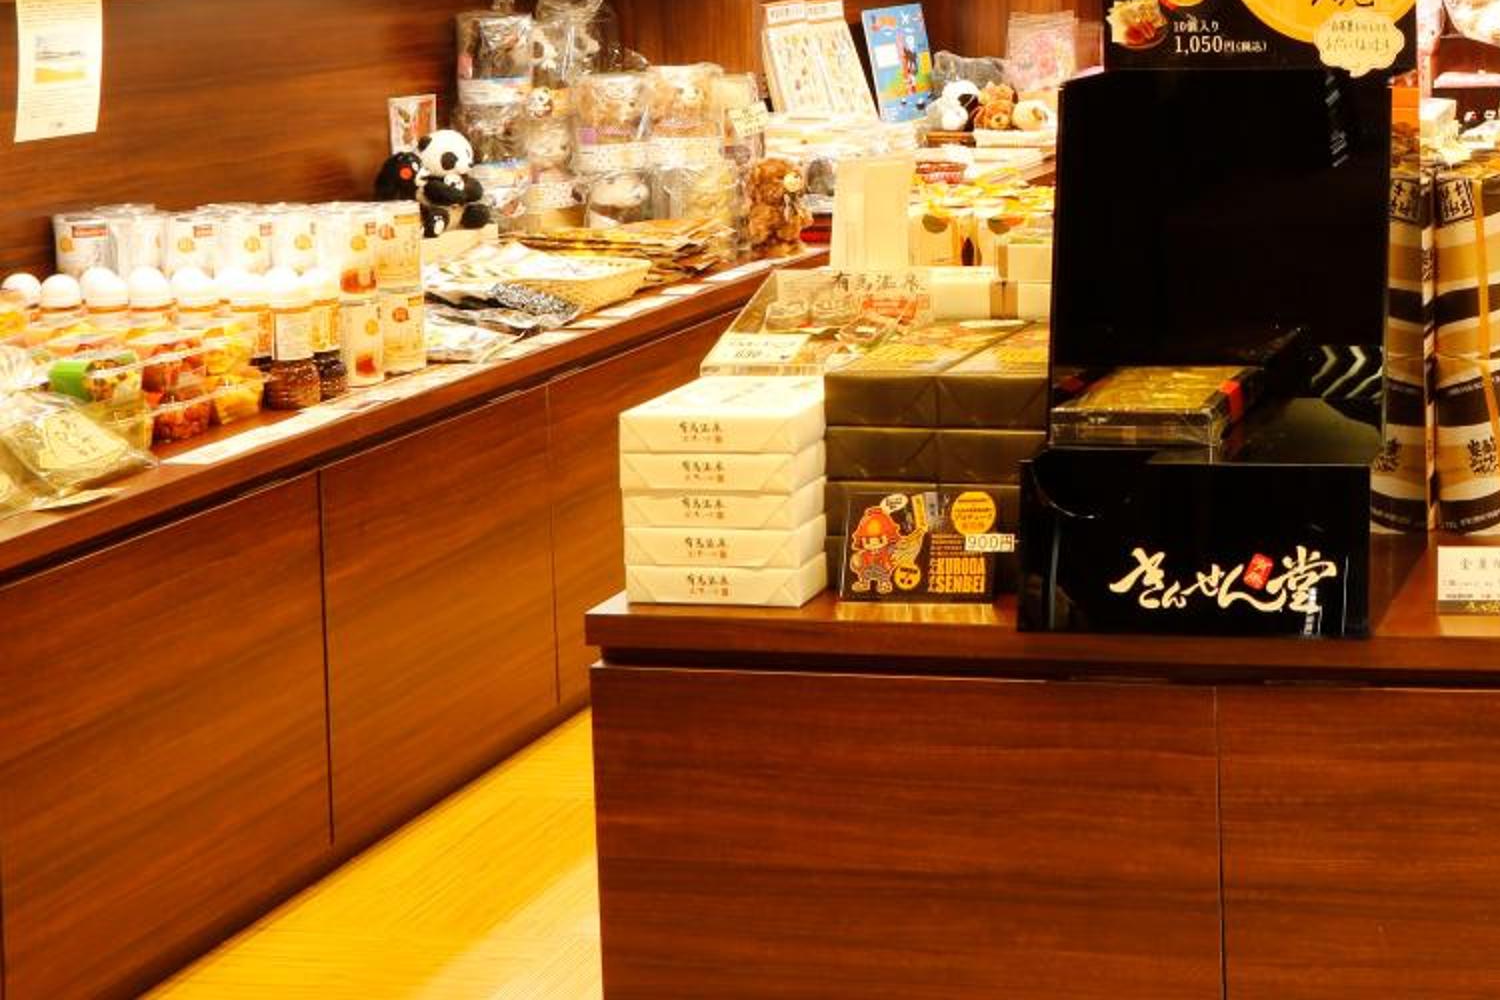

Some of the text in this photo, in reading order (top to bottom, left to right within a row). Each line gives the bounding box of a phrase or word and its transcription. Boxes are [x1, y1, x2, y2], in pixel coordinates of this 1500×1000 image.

[1109, 546, 1337, 614] きんせん堂
